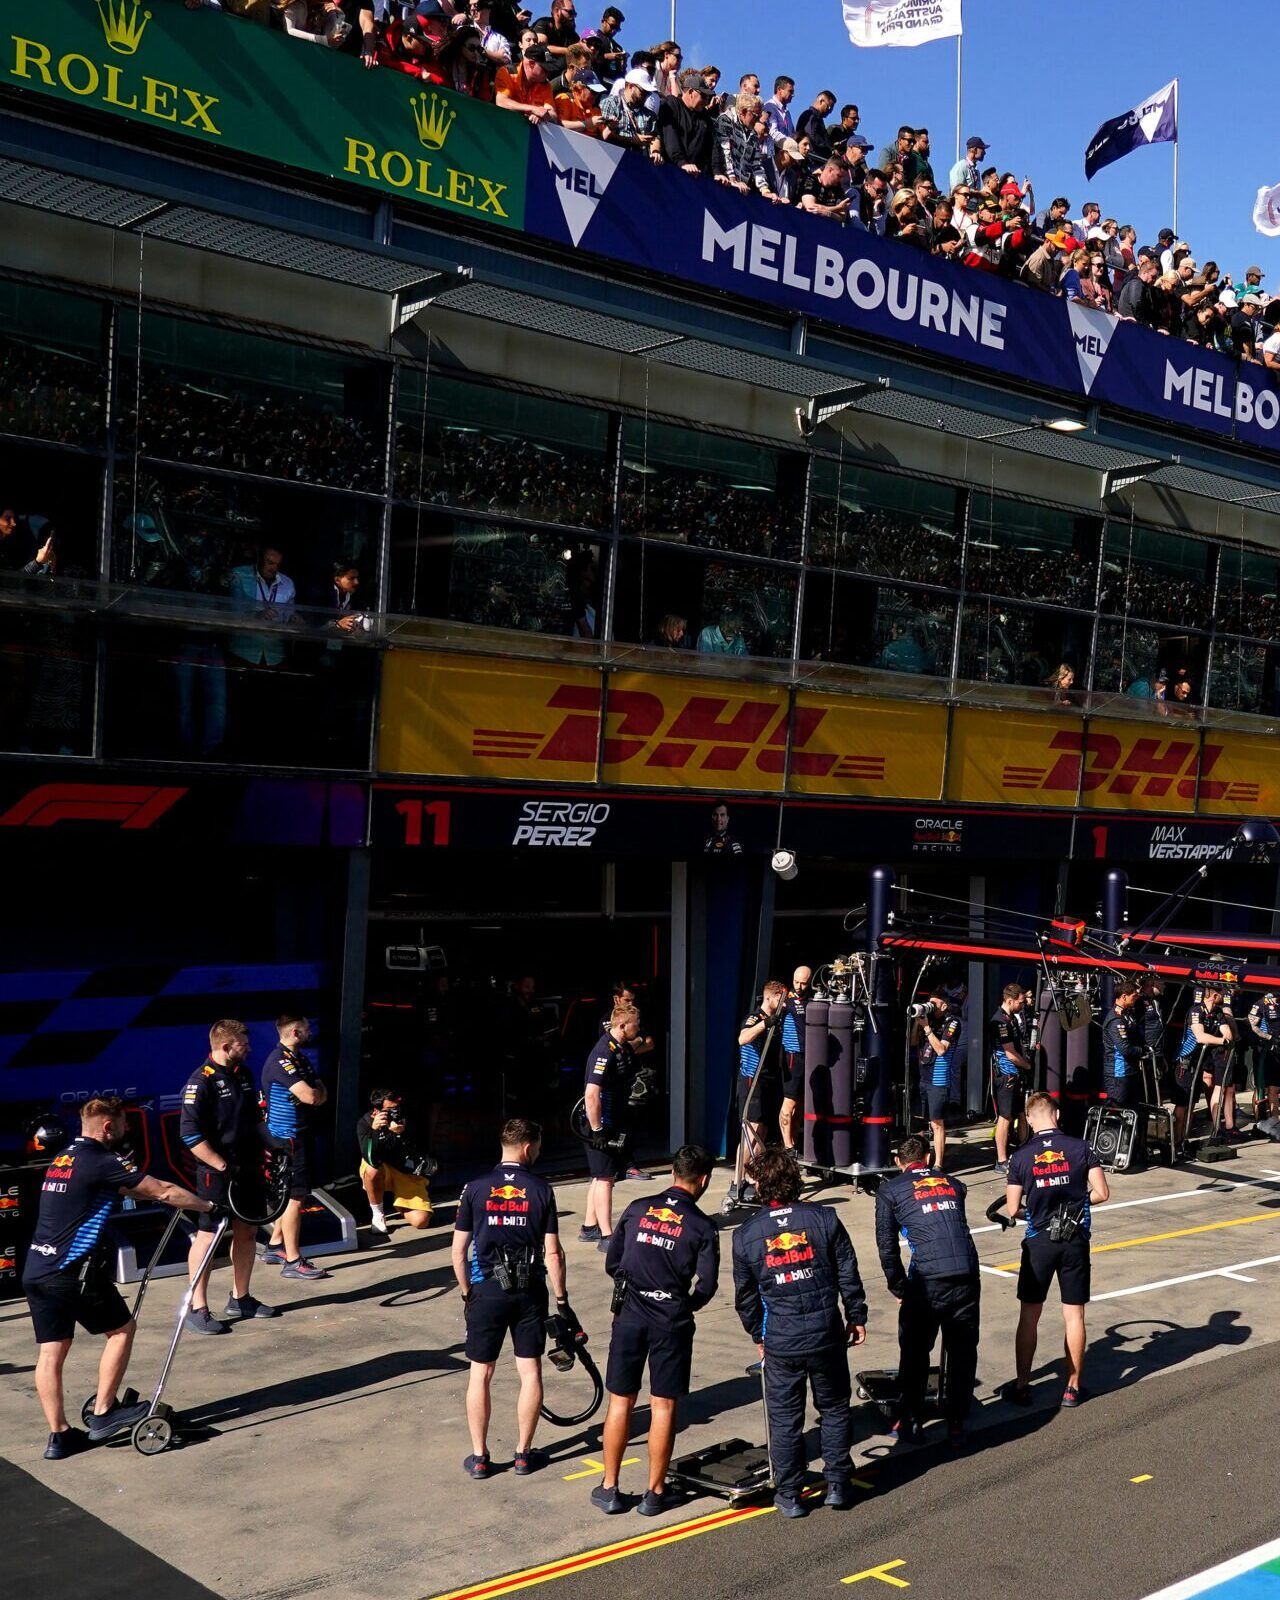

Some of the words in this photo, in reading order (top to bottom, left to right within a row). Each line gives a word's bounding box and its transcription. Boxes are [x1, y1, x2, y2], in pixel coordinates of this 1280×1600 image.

[10, 35, 222, 135] ROLEX
[343, 136, 509, 218] ROLEX
[548, 158, 603, 200] MEL
[701, 207, 1007, 351] MELBOURNE
[1074, 330, 1104, 358] MEL
[537, 684, 840, 777] DHL
[1041, 730, 1229, 800] DHL
[395, 800, 451, 845] 11
[518, 801, 610, 824] SERGIO
[915, 819, 963, 830] ORACLE
[1151, 825, 1187, 841] MAX
[512, 826, 597, 846] PEREZ
[1092, 826, 1108, 858] 1
[1149, 843, 1233, 860] VERSTAPPEN
[1197, 962, 1240, 972] ORACLE
[1032, 1163, 1052, 1176] Red
[1052, 1161, 1070, 1173] Bull
[914, 1186, 936, 1200] Red
[935, 1185, 957, 1198] Bull
[1035, 1177, 1060, 1188] Mobil
[486, 1200, 507, 1212] Red
[508, 1200, 529, 1212] Bull
[921, 1201, 950, 1214] Mobil
[488, 1215, 516, 1226] Mobil
[639, 1217, 660, 1231] Red
[659, 1221, 683, 1238] Bull
[637, 1232, 664, 1248] Mobil
[766, 1251, 791, 1268] Red
[791, 1246, 814, 1263] Bull
[775, 1269, 805, 1285] Mobil
